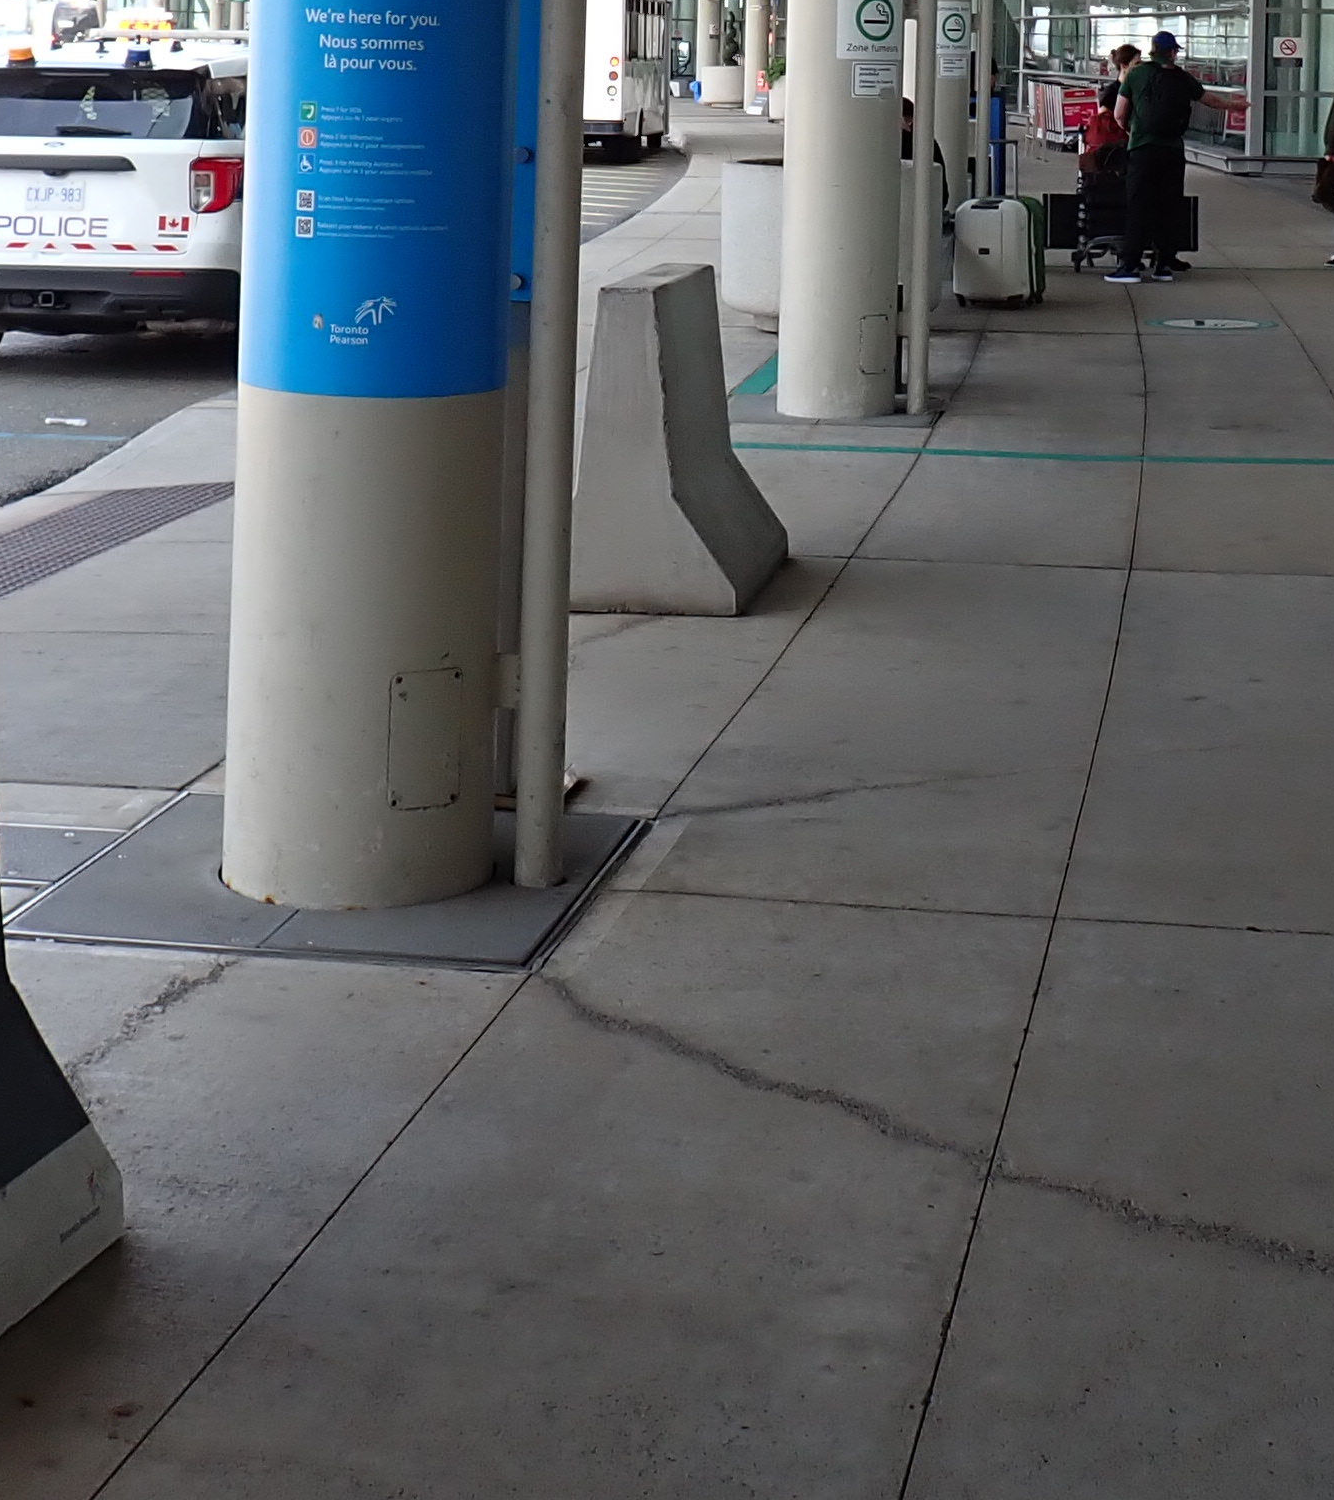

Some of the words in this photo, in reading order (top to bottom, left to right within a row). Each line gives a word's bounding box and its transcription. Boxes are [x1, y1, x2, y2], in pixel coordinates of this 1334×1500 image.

[305, 8, 345, 24] We're
[348, 9, 381, 25] here
[385, 10, 407, 26] for
[409, 13, 441, 30] you.
[319, 33, 358, 50] Nous
[360, 37, 425, 52] sommes
[846, 43, 869, 53] Zone
[323, 53, 338, 69] là
[340, 57, 376, 73] pour
[378, 58, 417, 72] vous.
[25, 187, 82, 203] CXJP-983
[329, 323, 369, 335] Toronto
[329, 334, 369, 346] Pearson
